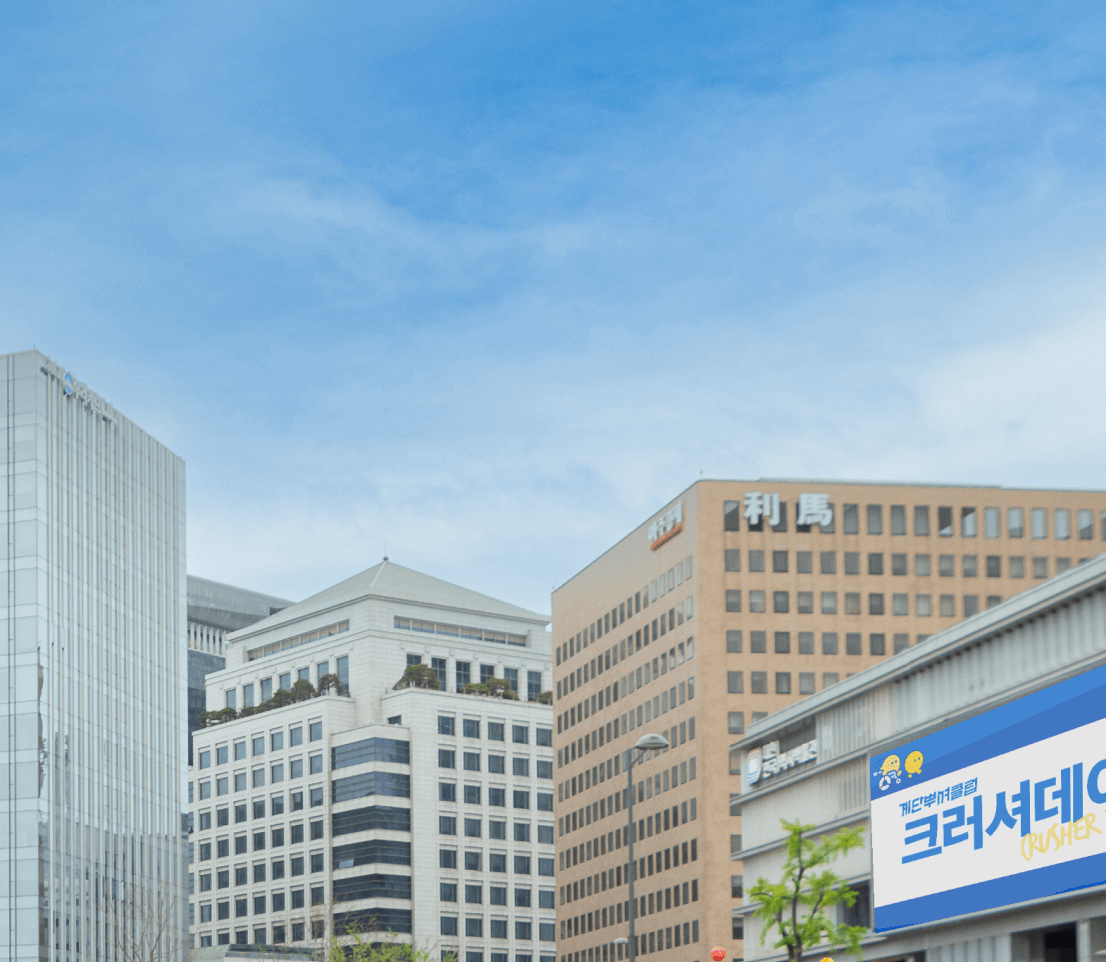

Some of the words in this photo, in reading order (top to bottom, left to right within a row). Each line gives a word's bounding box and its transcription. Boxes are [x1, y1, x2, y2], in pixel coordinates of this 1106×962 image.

[743, 491, 833, 527] 利馬
[899, 777, 978, 817] 계단뿌셔클럽
[1021, 813, 1102, 861] CRUSHER
